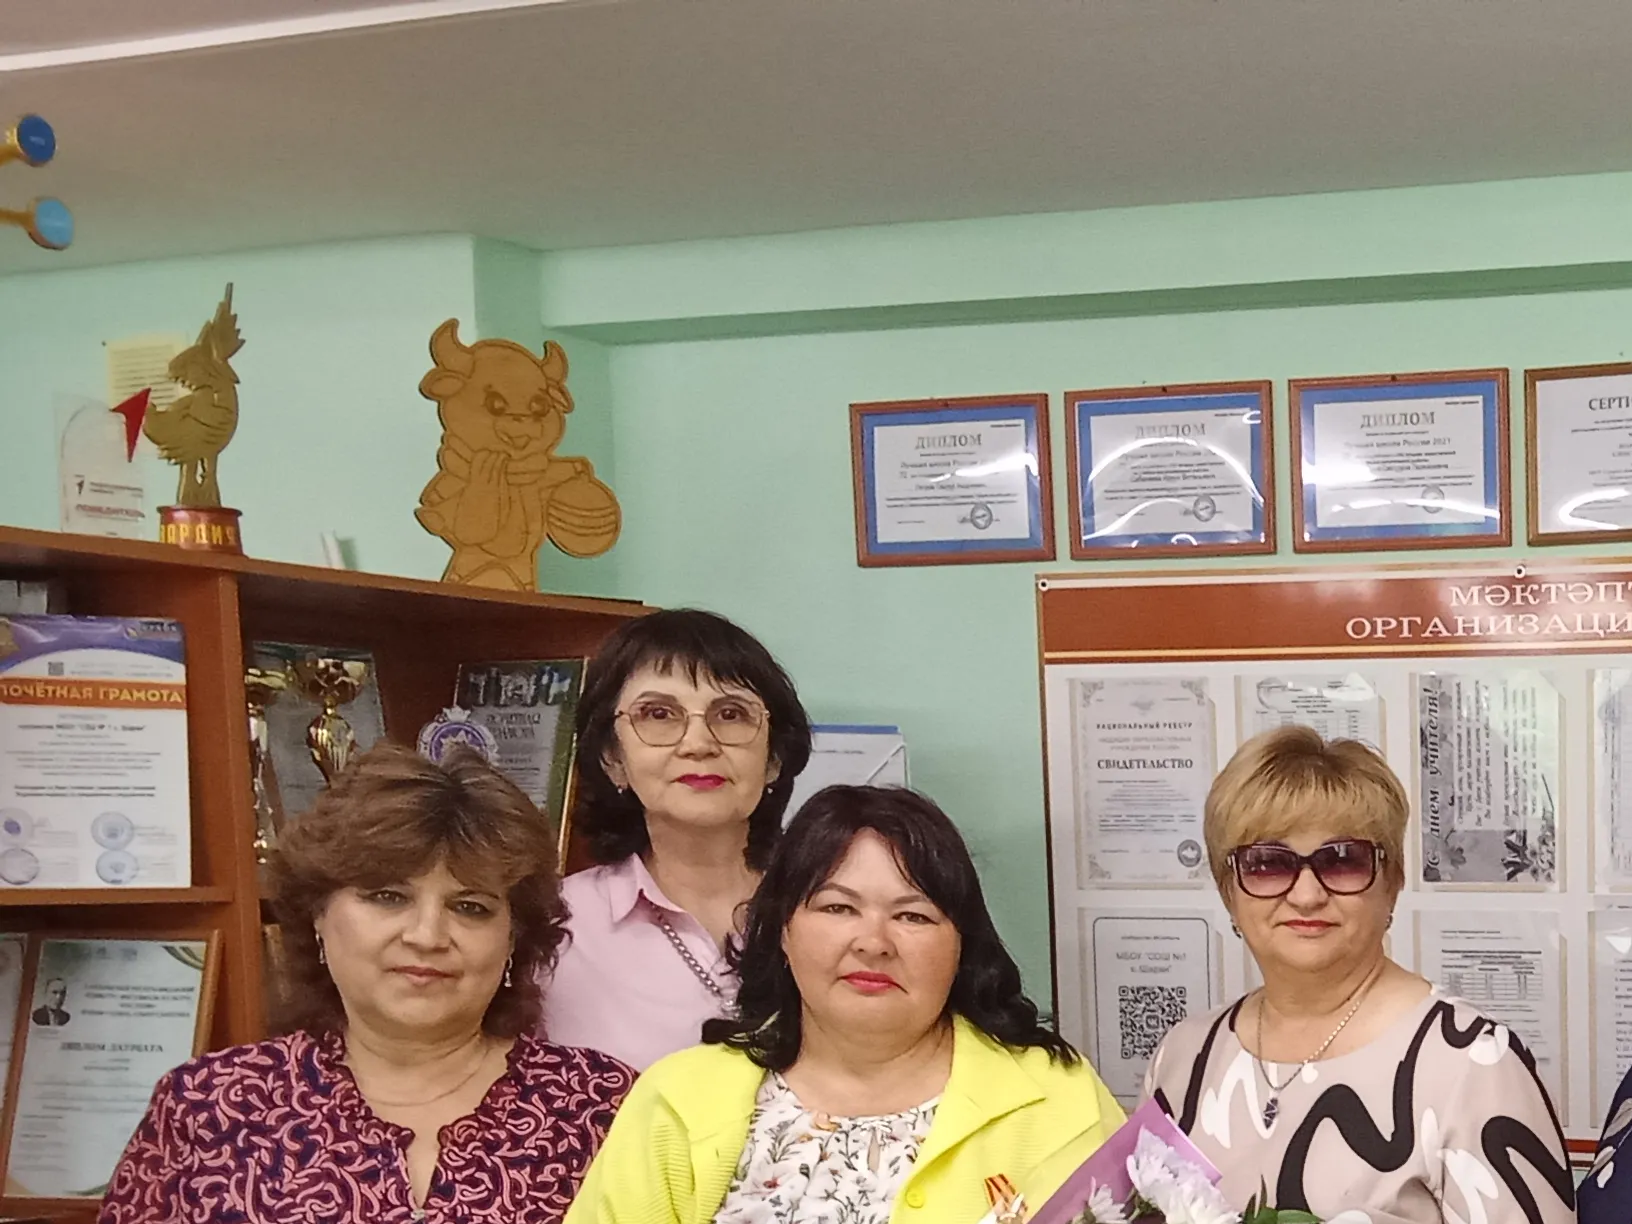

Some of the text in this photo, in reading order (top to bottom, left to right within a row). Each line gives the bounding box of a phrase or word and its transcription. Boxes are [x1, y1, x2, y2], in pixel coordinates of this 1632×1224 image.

[1360, 411, 1436, 429] ДИПЛОМ
[915, 432, 982, 450] ДИПЛОМ
[100, 687, 183, 703] ГРАМОТА
[1097, 758, 1194, 770] СВИДЕТЕЛЬСТВО
